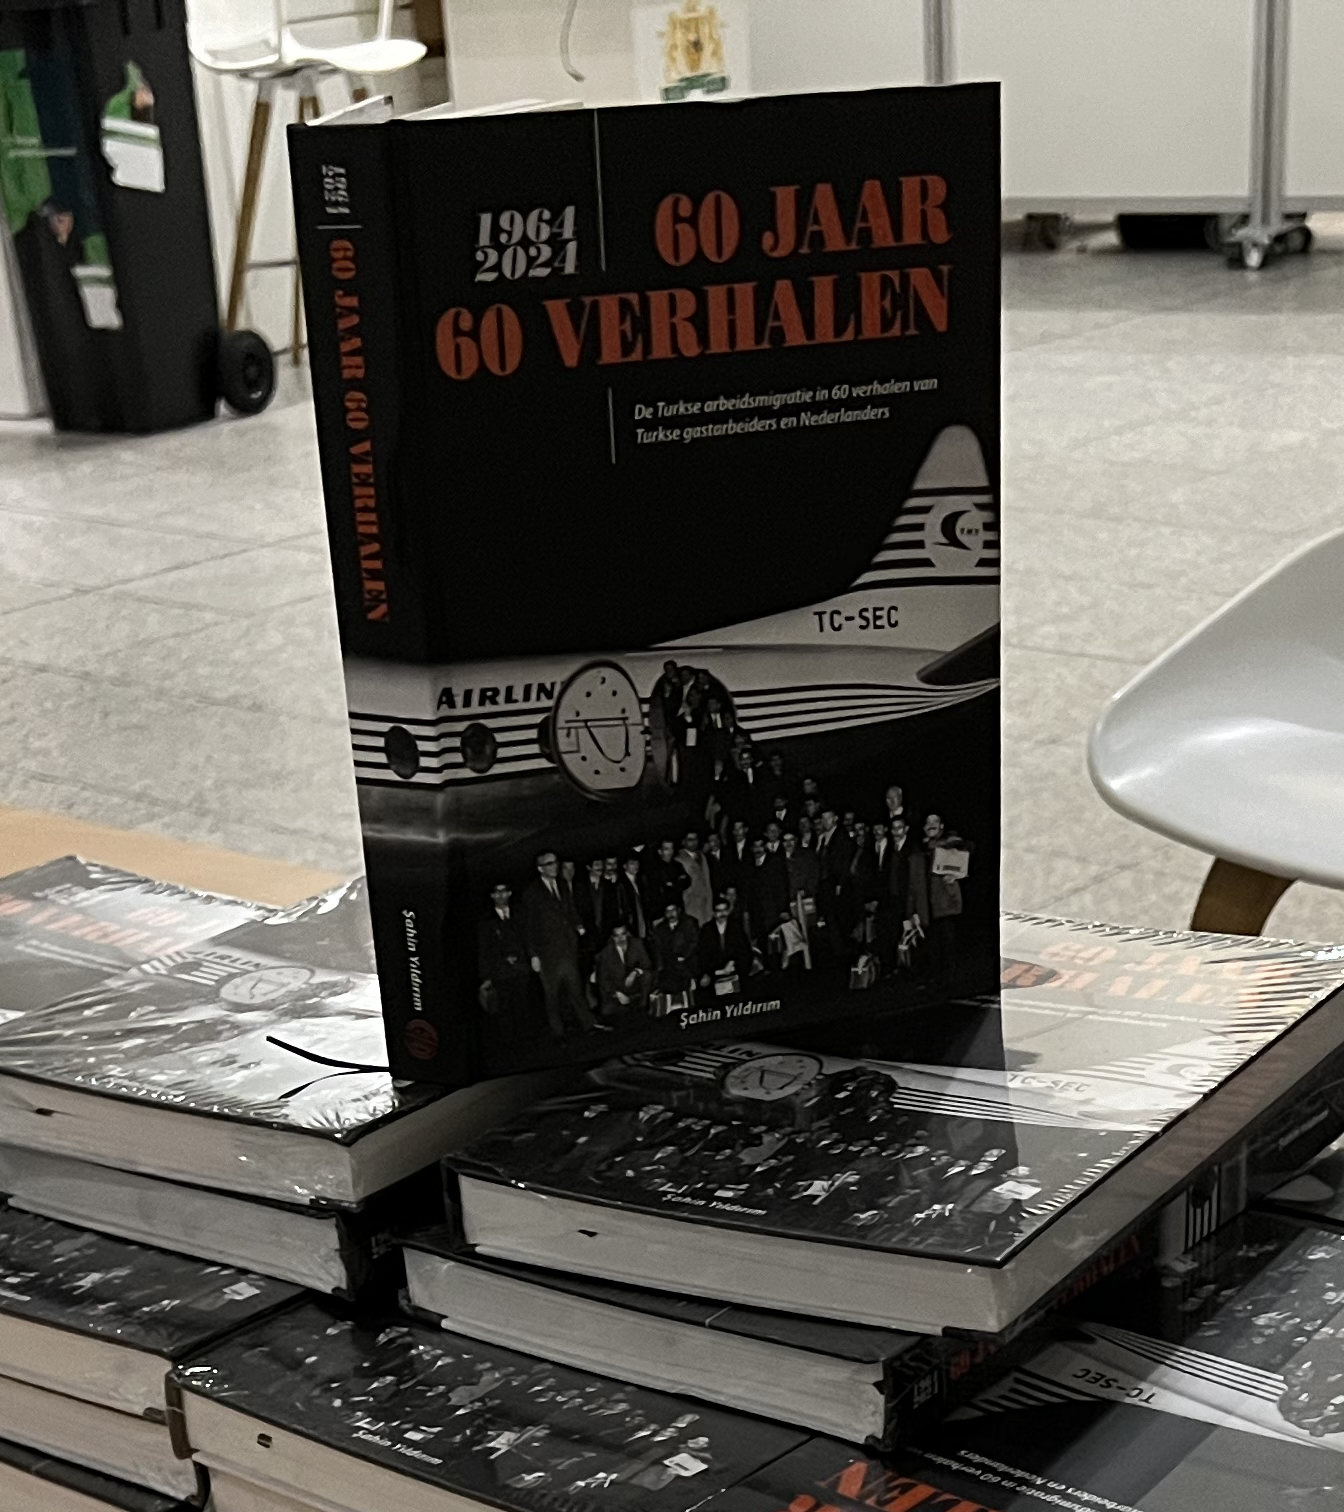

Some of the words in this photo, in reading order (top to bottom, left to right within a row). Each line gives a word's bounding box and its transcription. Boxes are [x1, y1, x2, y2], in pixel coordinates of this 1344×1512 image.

[475, 205, 577, 248] 1964
[655, 189, 740, 267] 60
[761, 174, 953, 259] JAAR
[329, 239, 356, 279] 60
[475, 241, 579, 282] 2024
[334, 290, 365, 379] JAAR
[435, 303, 523, 381] 60
[542, 265, 954, 369] VERHALEN
[344, 391, 369, 429] 60
[634, 403, 653, 420] De
[657, 401, 701, 418] Turkse
[704, 387, 813, 413] arbeidsmigratie
[816, 386, 829, 400] in
[831, 384, 849, 399] 60
[852, 378, 910, 397] verhalen
[913, 376, 938, 391] van
[636, 427, 681, 445] Turkse
[683, 414, 777, 442] gastarbeiders
[780, 414, 797, 427] en
[800, 405, 890, 426] Nederlanders
[348, 439, 389, 621] VERHALEN
[813, 605, 899, 632] TC-SEC
[401, 909, 421, 954] Şahin
[407, 956, 425, 1012] Yıldırım
[679, 1006, 721, 1030] Şahin
[724, 999, 781, 1020] Yıldırım
[1007, 1071, 1092, 1094] TC-SEC
[1071, 1367, 1157, 1405] TC-SEC
[979, 1473, 1001, 1484] 60
[1001, 1480, 1017, 1489] in
[1046, 1480, 1067, 1490] en
